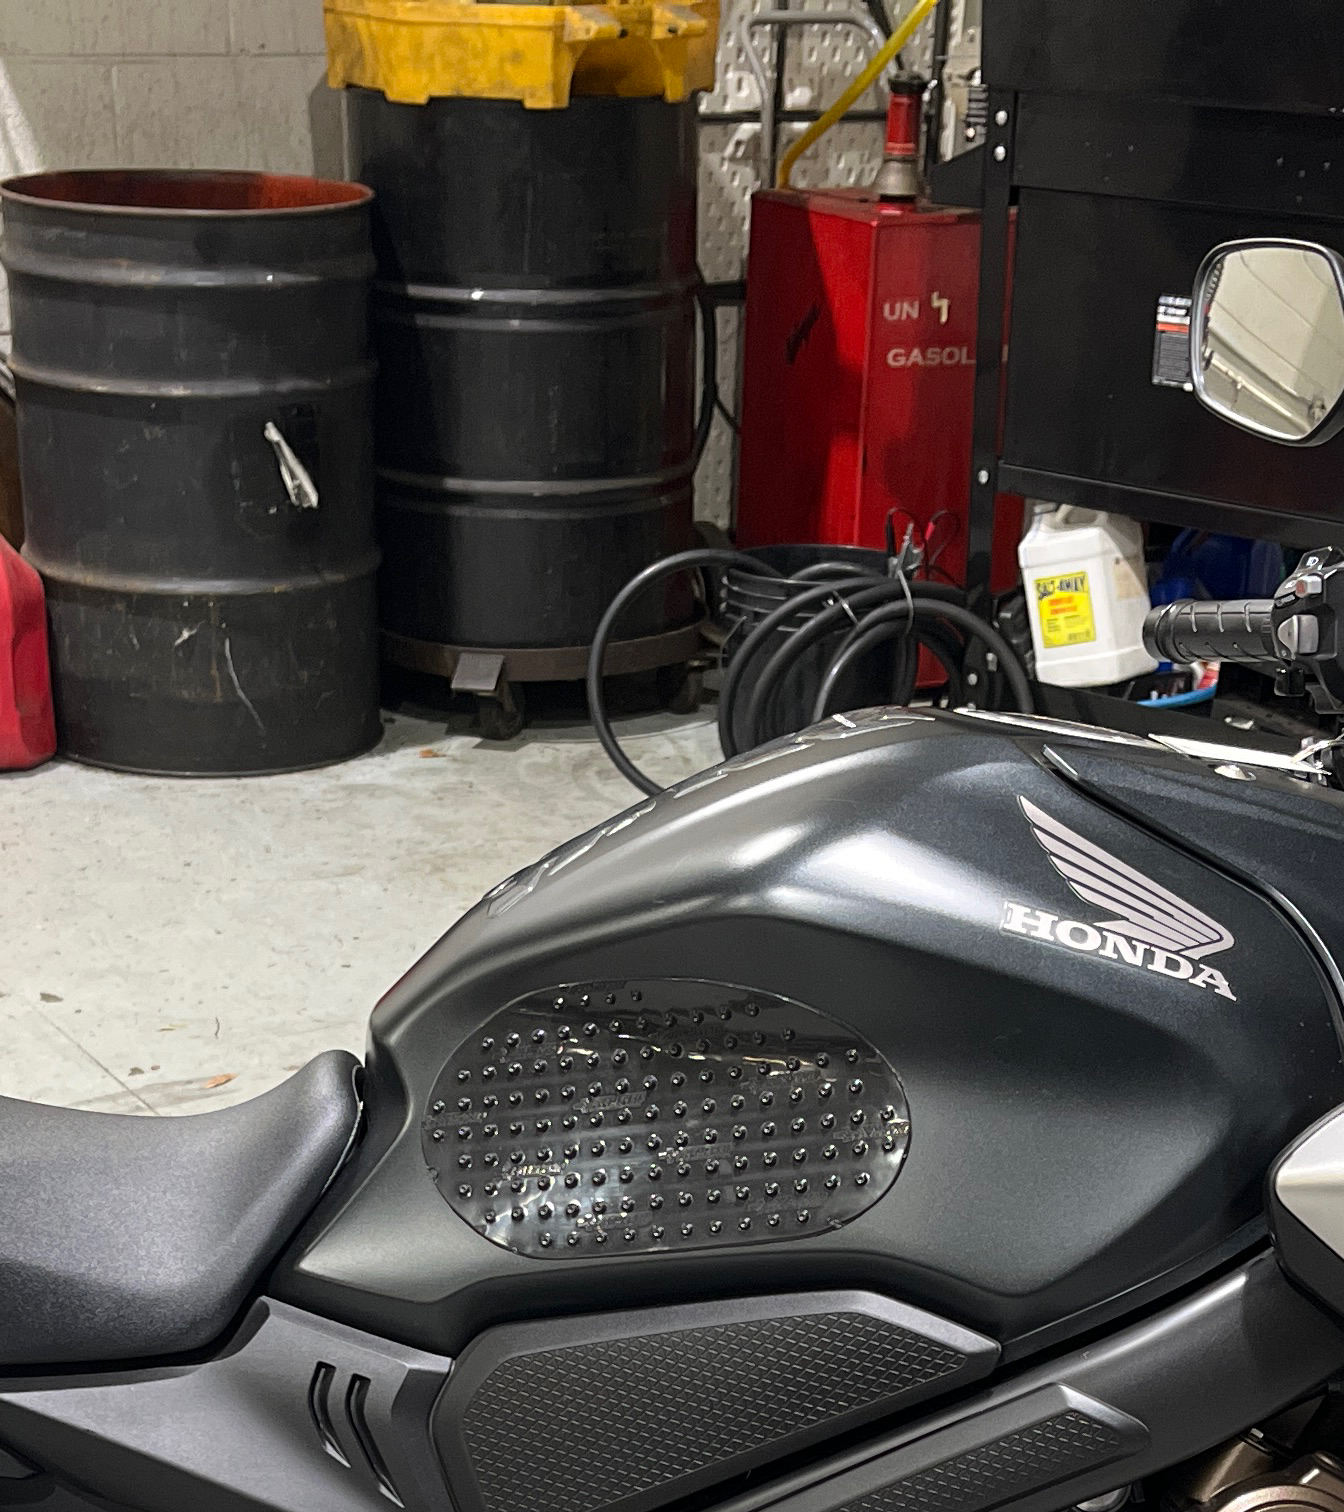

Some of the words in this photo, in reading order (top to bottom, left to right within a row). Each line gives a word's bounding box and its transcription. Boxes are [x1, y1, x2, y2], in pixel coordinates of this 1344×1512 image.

[883, 300, 920, 320] UN
[886, 345, 1008, 369] GASOL
[1002, 900, 1237, 1001] HONDA
